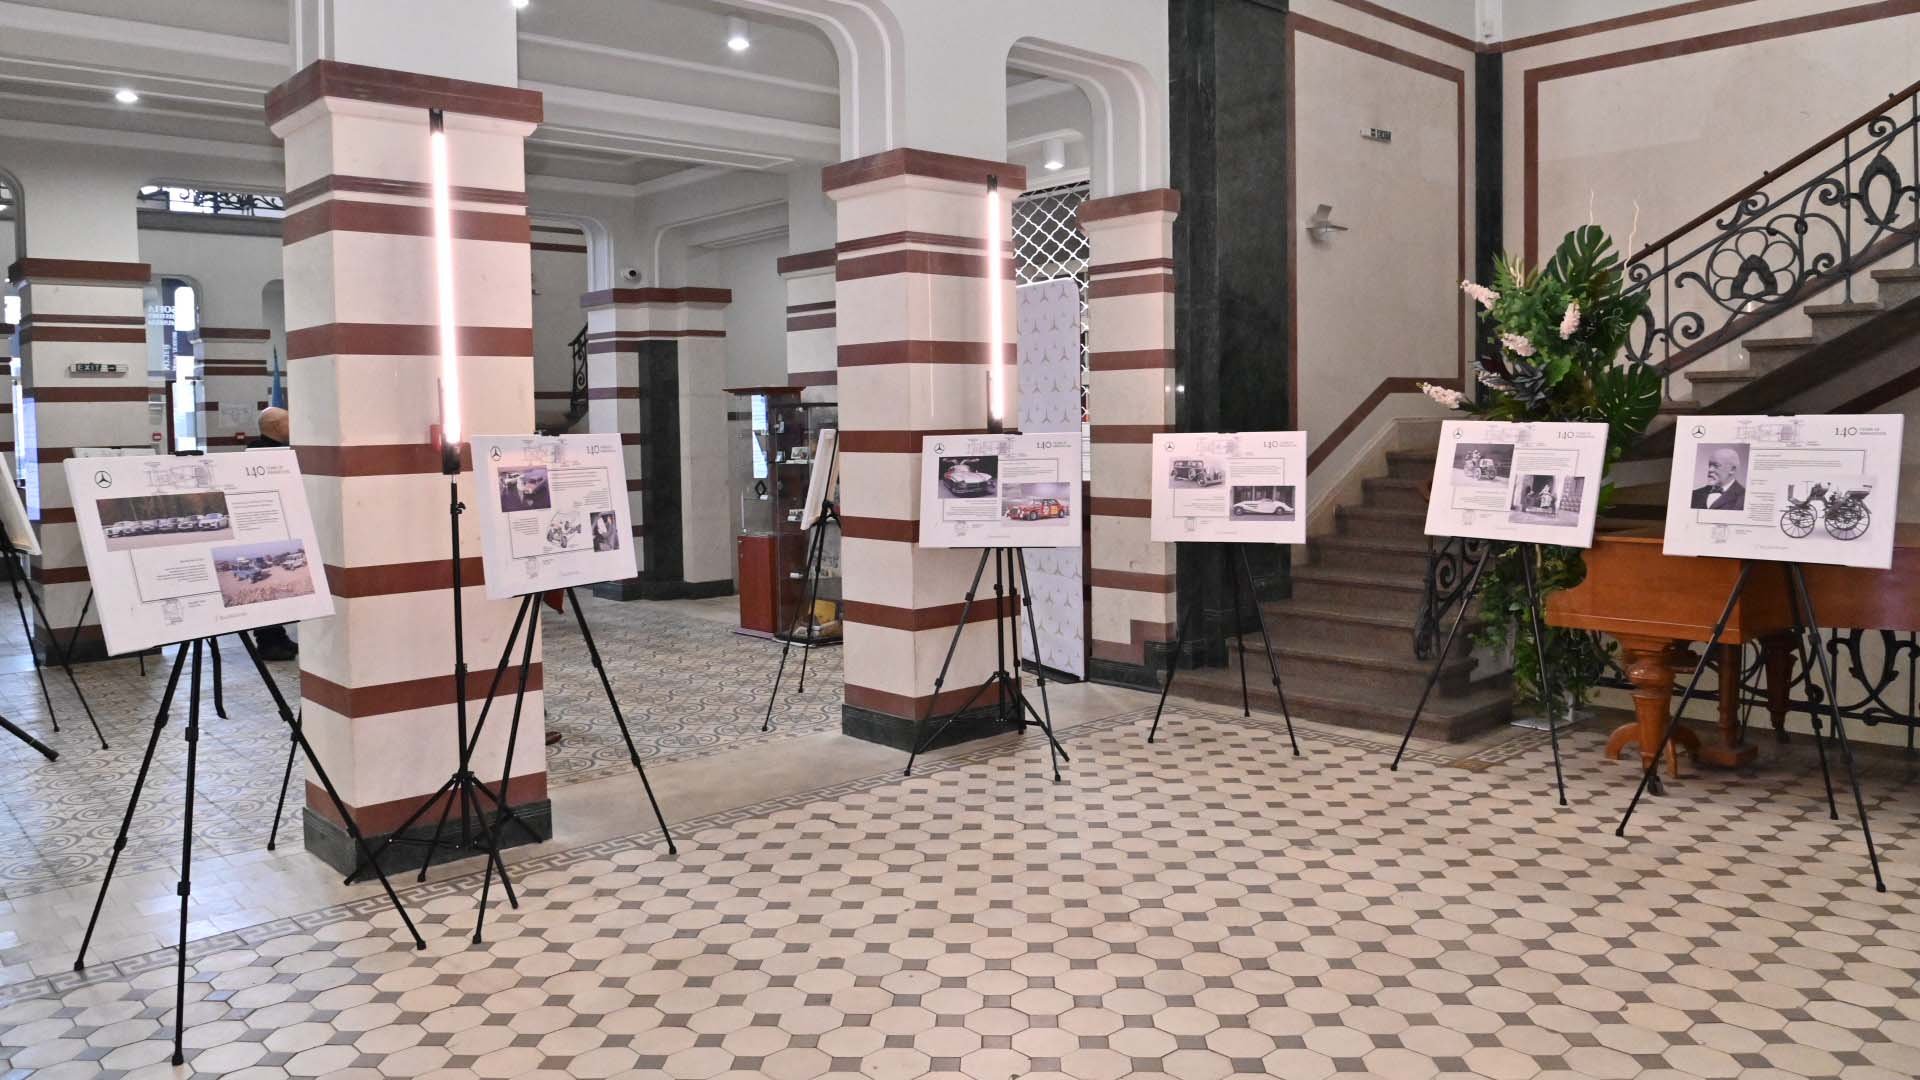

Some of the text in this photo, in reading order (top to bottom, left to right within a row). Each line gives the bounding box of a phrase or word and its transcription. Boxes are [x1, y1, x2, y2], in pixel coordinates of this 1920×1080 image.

[77, 364, 100, 372] EXIT
[1835, 426, 1857, 438] 140
[245, 465, 266, 478] 140
